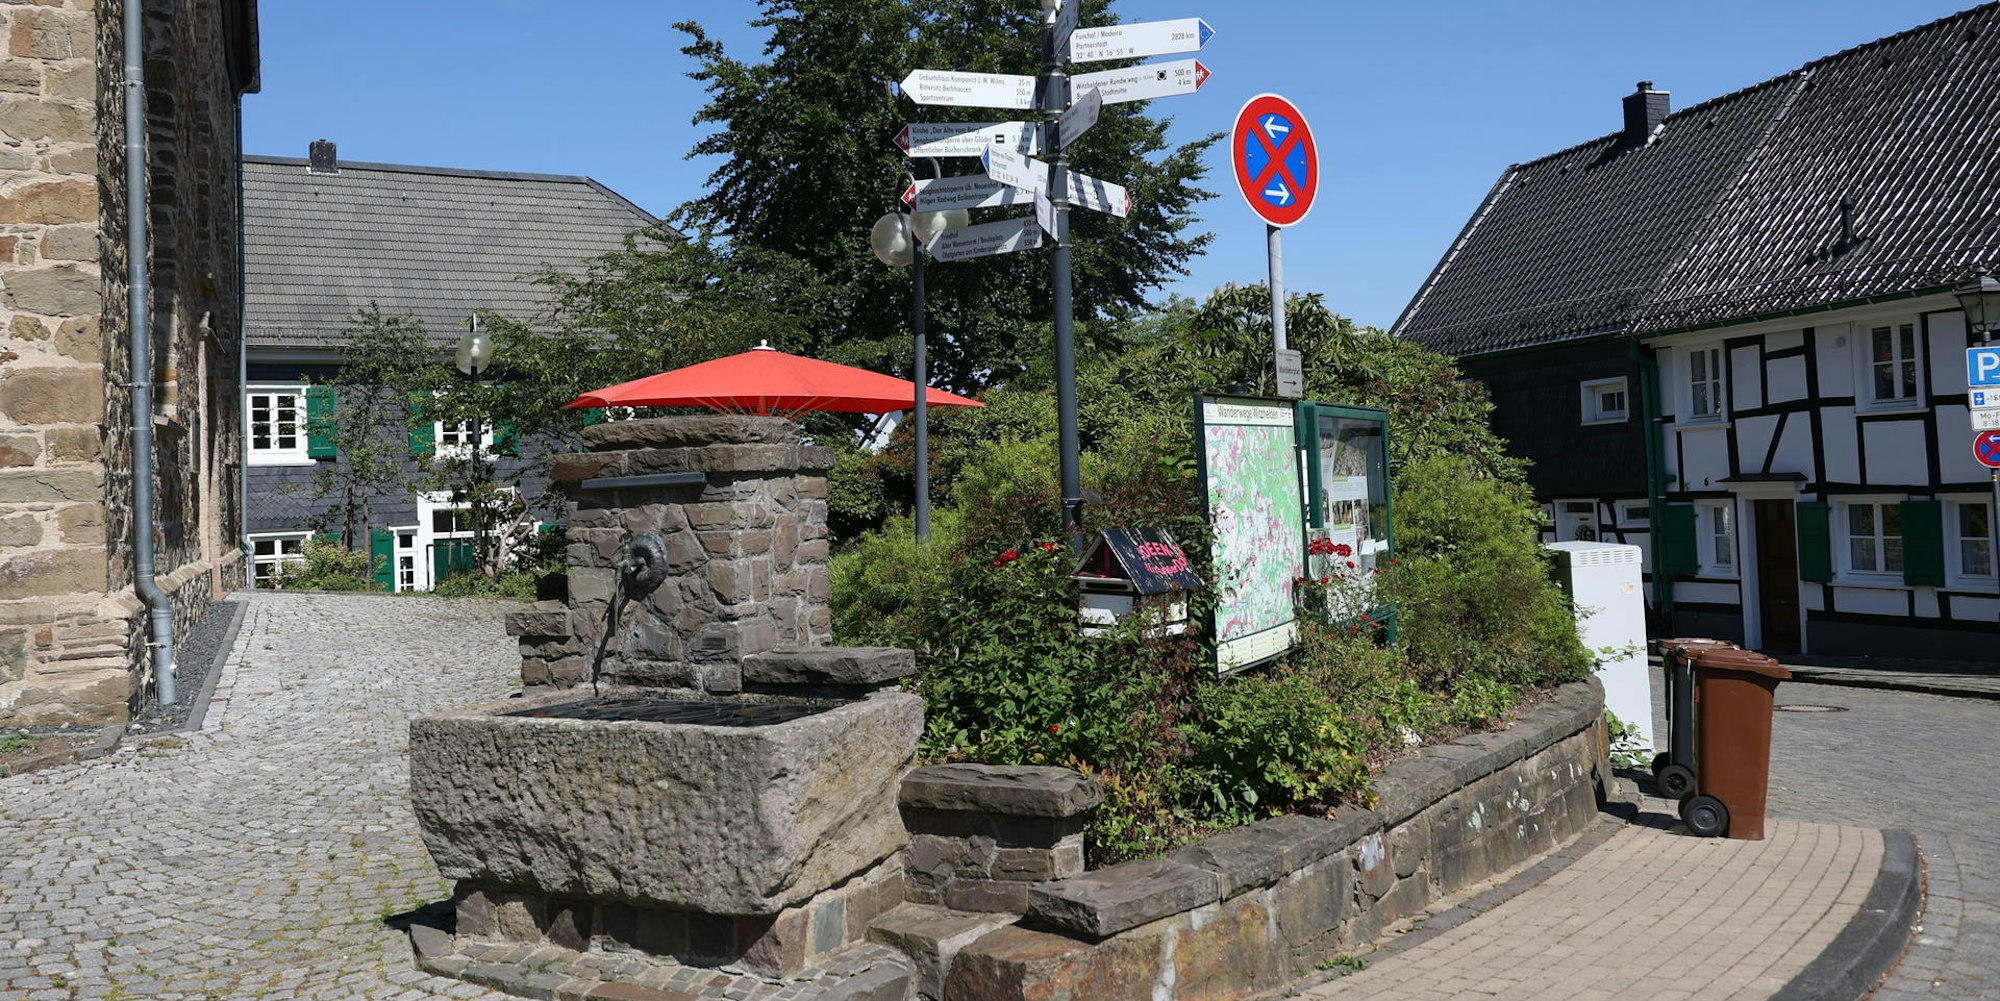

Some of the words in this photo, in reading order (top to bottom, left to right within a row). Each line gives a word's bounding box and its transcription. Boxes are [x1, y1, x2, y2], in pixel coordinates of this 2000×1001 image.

[1101, 29, 1122, 38] Madeira
[1171, 32, 1185, 41] 2828
[1076, 41, 1108, 50] Partnerstadt
[918, 73, 950, 82] Geburtshaus
[1174, 69, 1185, 77] 500
[1183, 78, 1191, 86] km
[920, 94, 954, 103] Sportzentrum
[943, 126, 954, 134] Alte
[1977, 352, 1999, 381] P
[1218, 405, 1253, 422] Wanderwege
[1253, 406, 1279, 420] Witzhelden
[1703, 476, 1709, 487] 6
